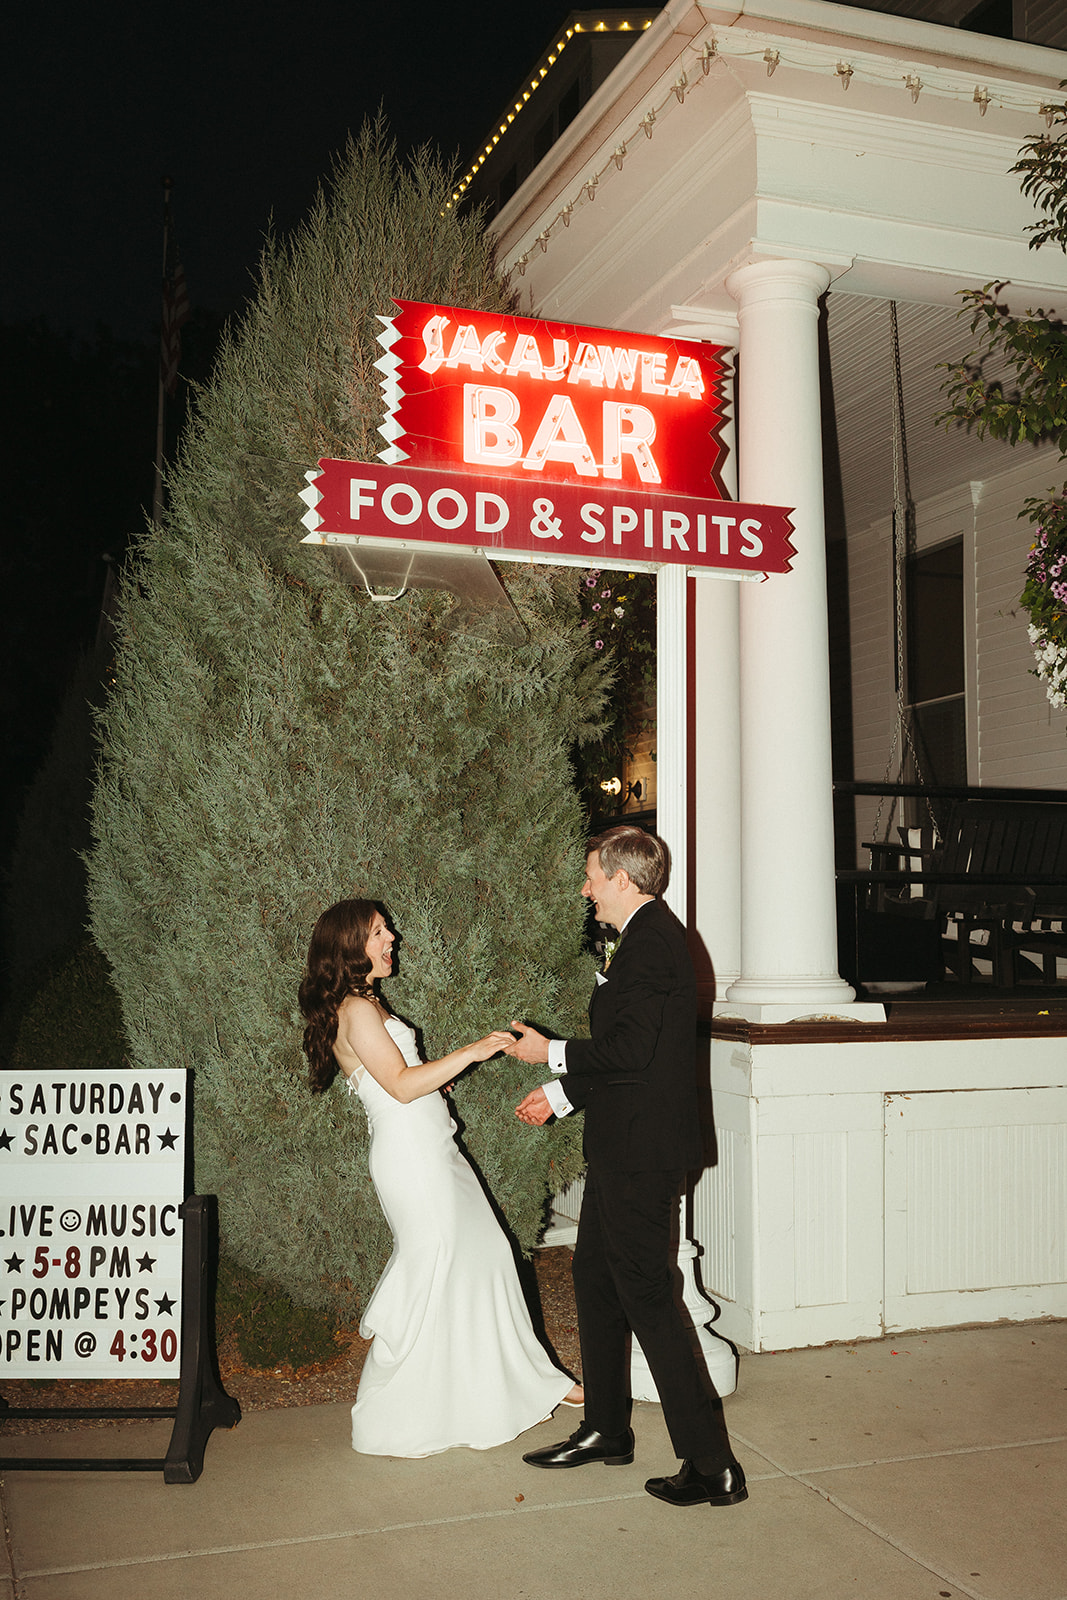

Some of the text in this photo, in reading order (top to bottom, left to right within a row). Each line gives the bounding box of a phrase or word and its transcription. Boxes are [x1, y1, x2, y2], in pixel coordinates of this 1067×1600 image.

[417, 314, 705, 400] SACAJAWEA
[463, 382, 662, 484] BAR
[349, 478, 764, 559] FOOD & SPIRITS
[9, 1082, 165, 1115] SATURDAY
[0, 1204, 176, 1237] IVE MUSIC
[32, 1246, 131, 1279] 5-8 PM
[11, 1286, 150, 1320] POMPEYS
[74, 1331, 97, 1359] @
[109, 1328, 178, 1362] 4:30
